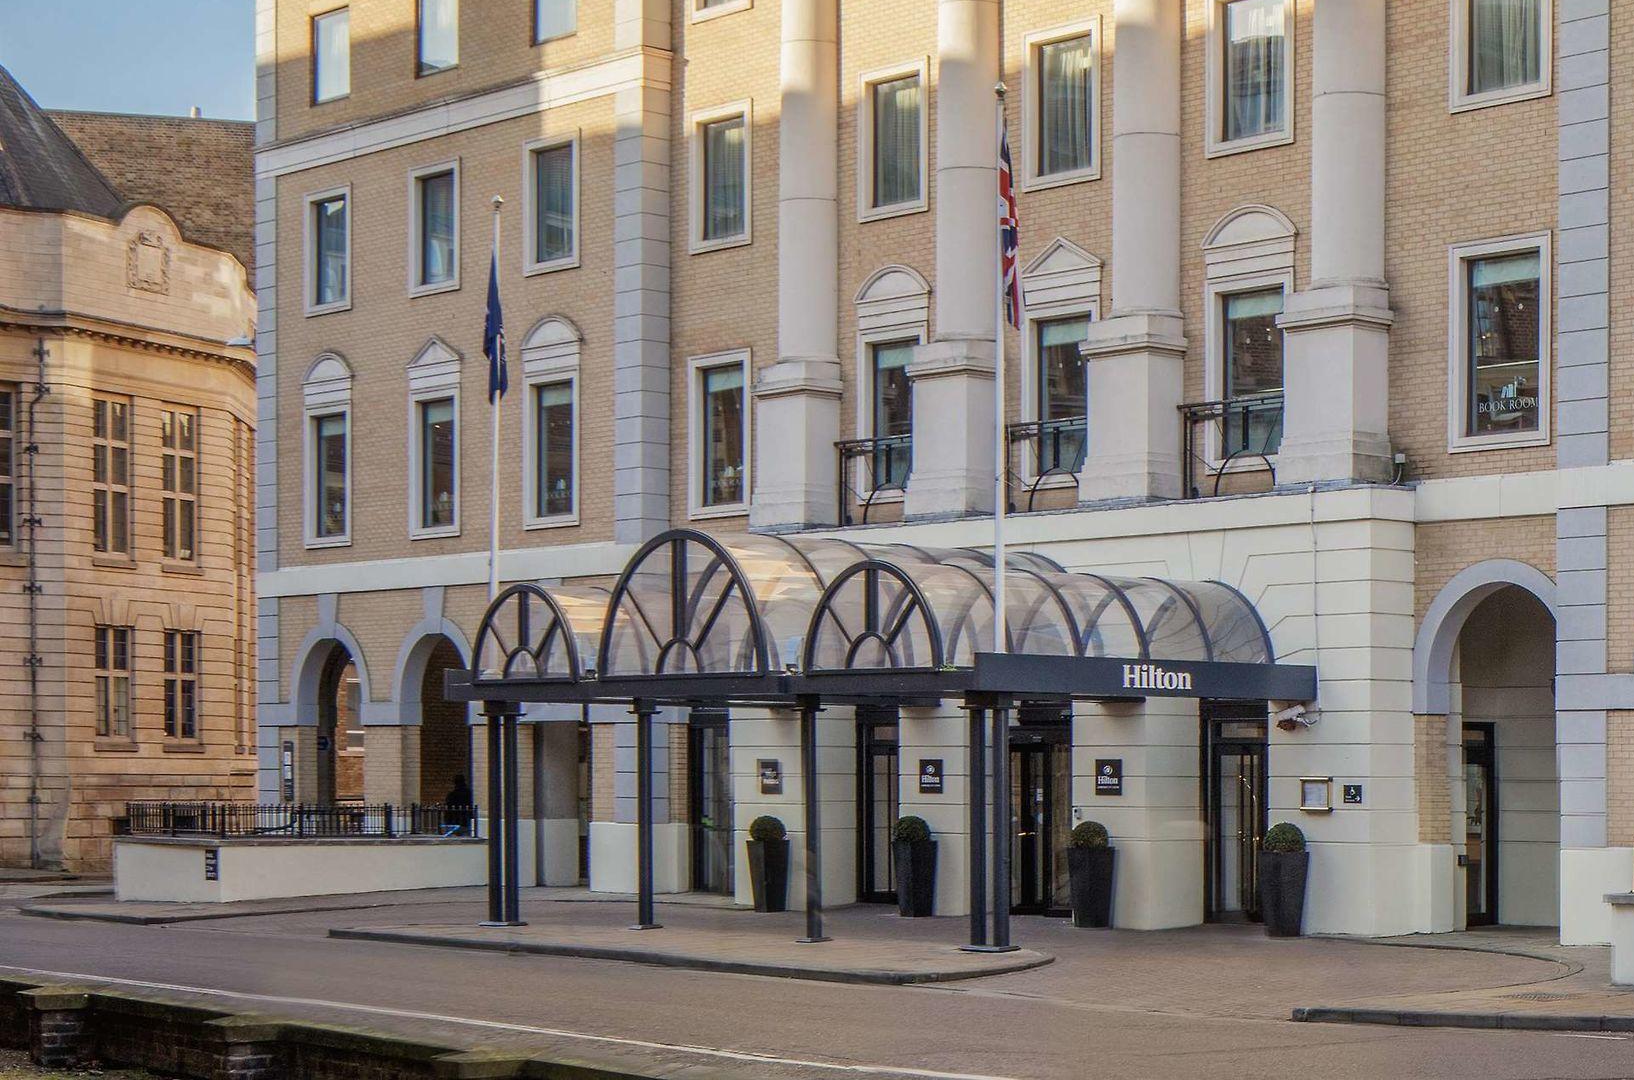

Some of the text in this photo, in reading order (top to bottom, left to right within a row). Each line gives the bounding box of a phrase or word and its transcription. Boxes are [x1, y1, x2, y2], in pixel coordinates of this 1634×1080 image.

[1479, 397, 1539, 413] BOOK ROOM
[1122, 664, 1192, 690] Hilton
